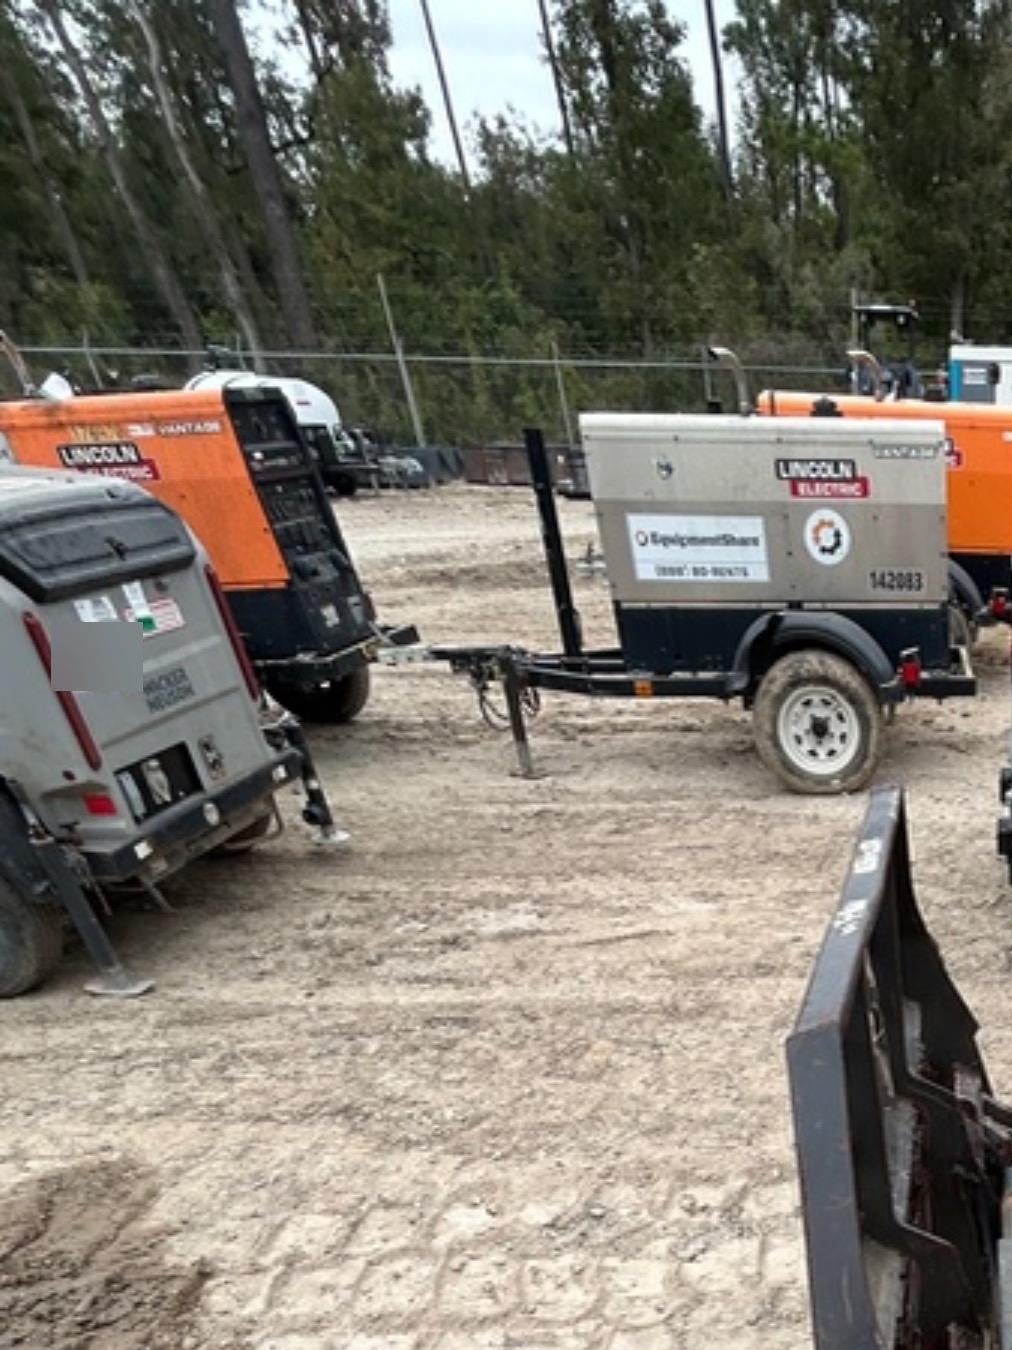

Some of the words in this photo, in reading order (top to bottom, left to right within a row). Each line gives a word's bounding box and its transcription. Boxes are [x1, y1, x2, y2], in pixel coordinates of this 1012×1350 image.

[61, 444, 138, 467] LINCOLN
[779, 461, 853, 478] LINCOLN
[796, 481, 863, 496] ELECTRIC
[650, 530, 760, 549] EquipmentShare
[869, 571, 922, 592] 142083
